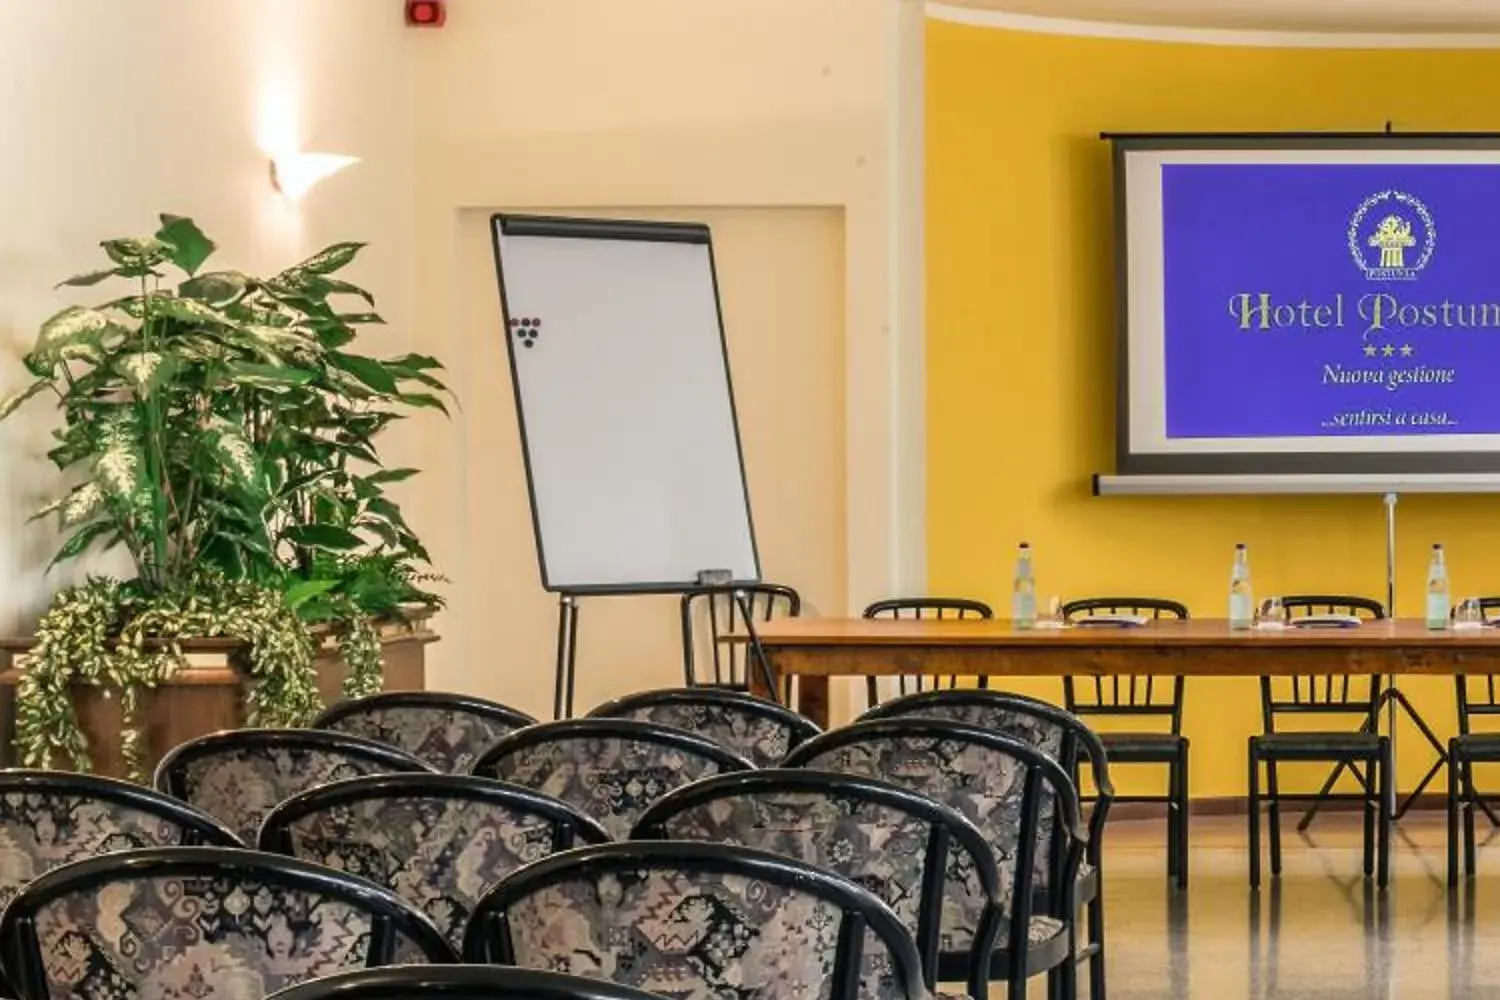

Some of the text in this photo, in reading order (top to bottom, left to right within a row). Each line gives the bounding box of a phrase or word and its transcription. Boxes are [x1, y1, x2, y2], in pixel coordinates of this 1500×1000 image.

[1229, 293, 1344, 329] Hotel
[1322, 363, 1456, 391] Nuova gestione
[1394, 412, 1407, 425] a
